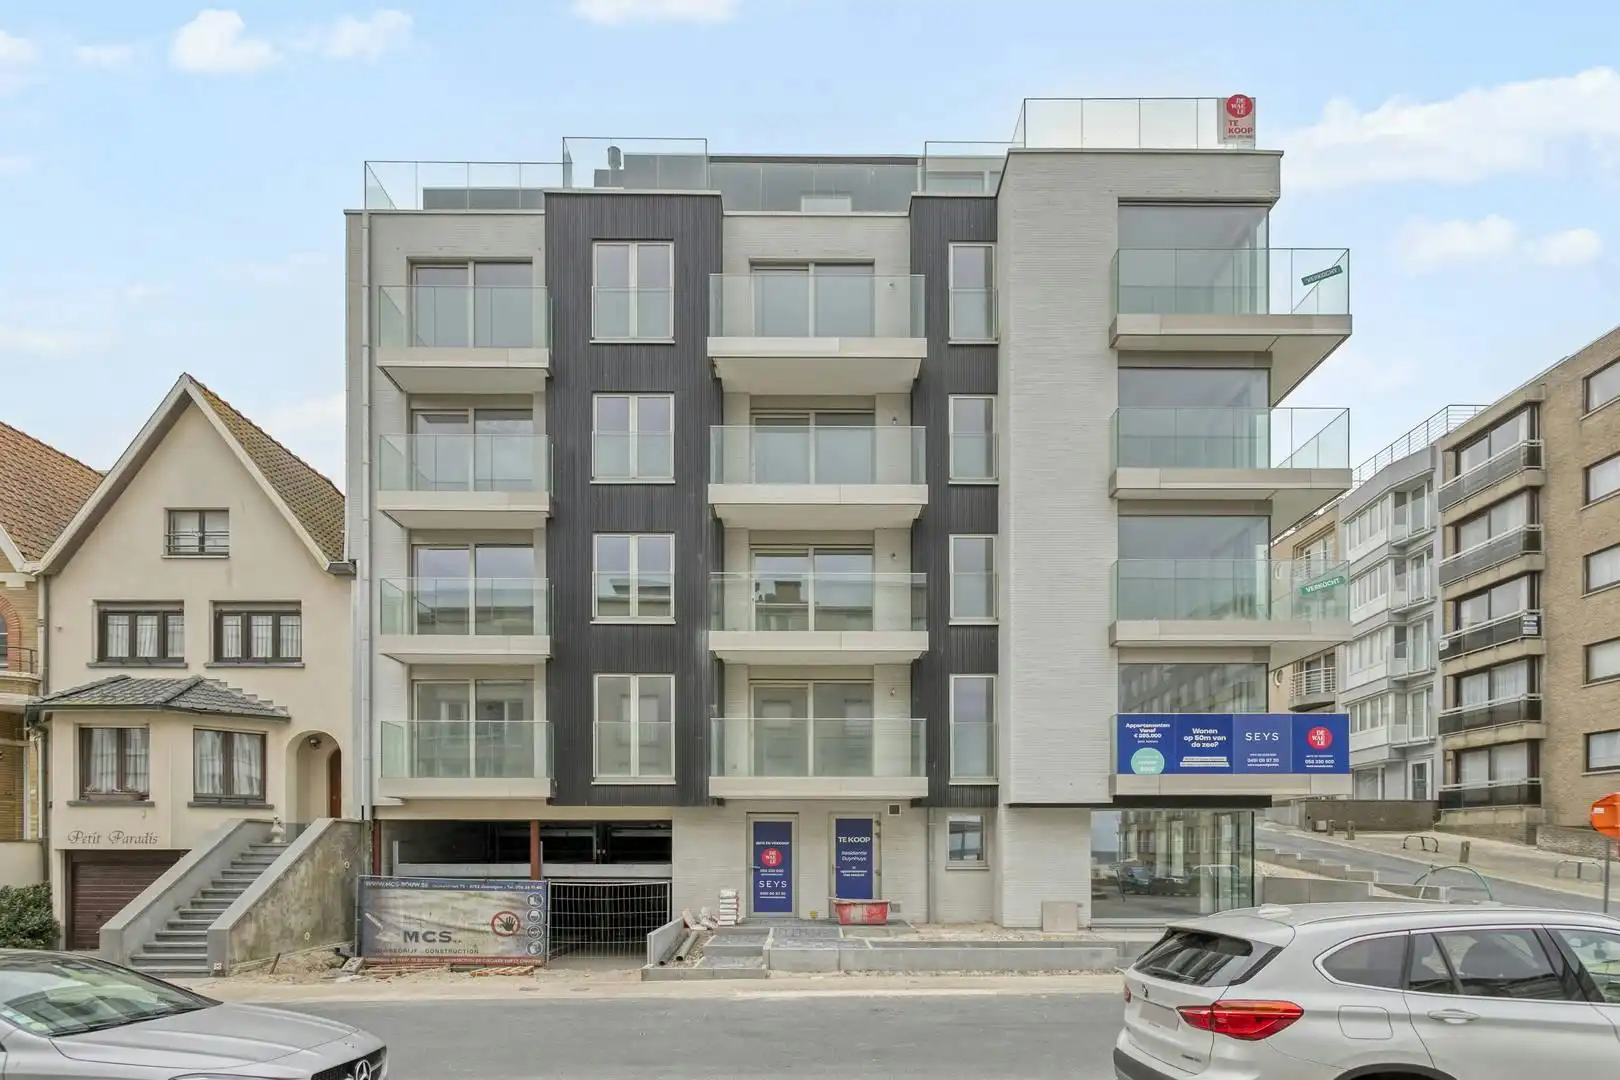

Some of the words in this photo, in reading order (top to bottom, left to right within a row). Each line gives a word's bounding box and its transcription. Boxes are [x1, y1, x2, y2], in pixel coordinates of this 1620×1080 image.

[1305, 577, 1340, 593] VERKOCHT
[1245, 732, 1279, 741] SEYS
[67, 830, 102, 845] Petit
[108, 830, 159, 845] Paradis
[759, 880, 787, 888] SEYS
[403, 930, 453, 943] MCS
